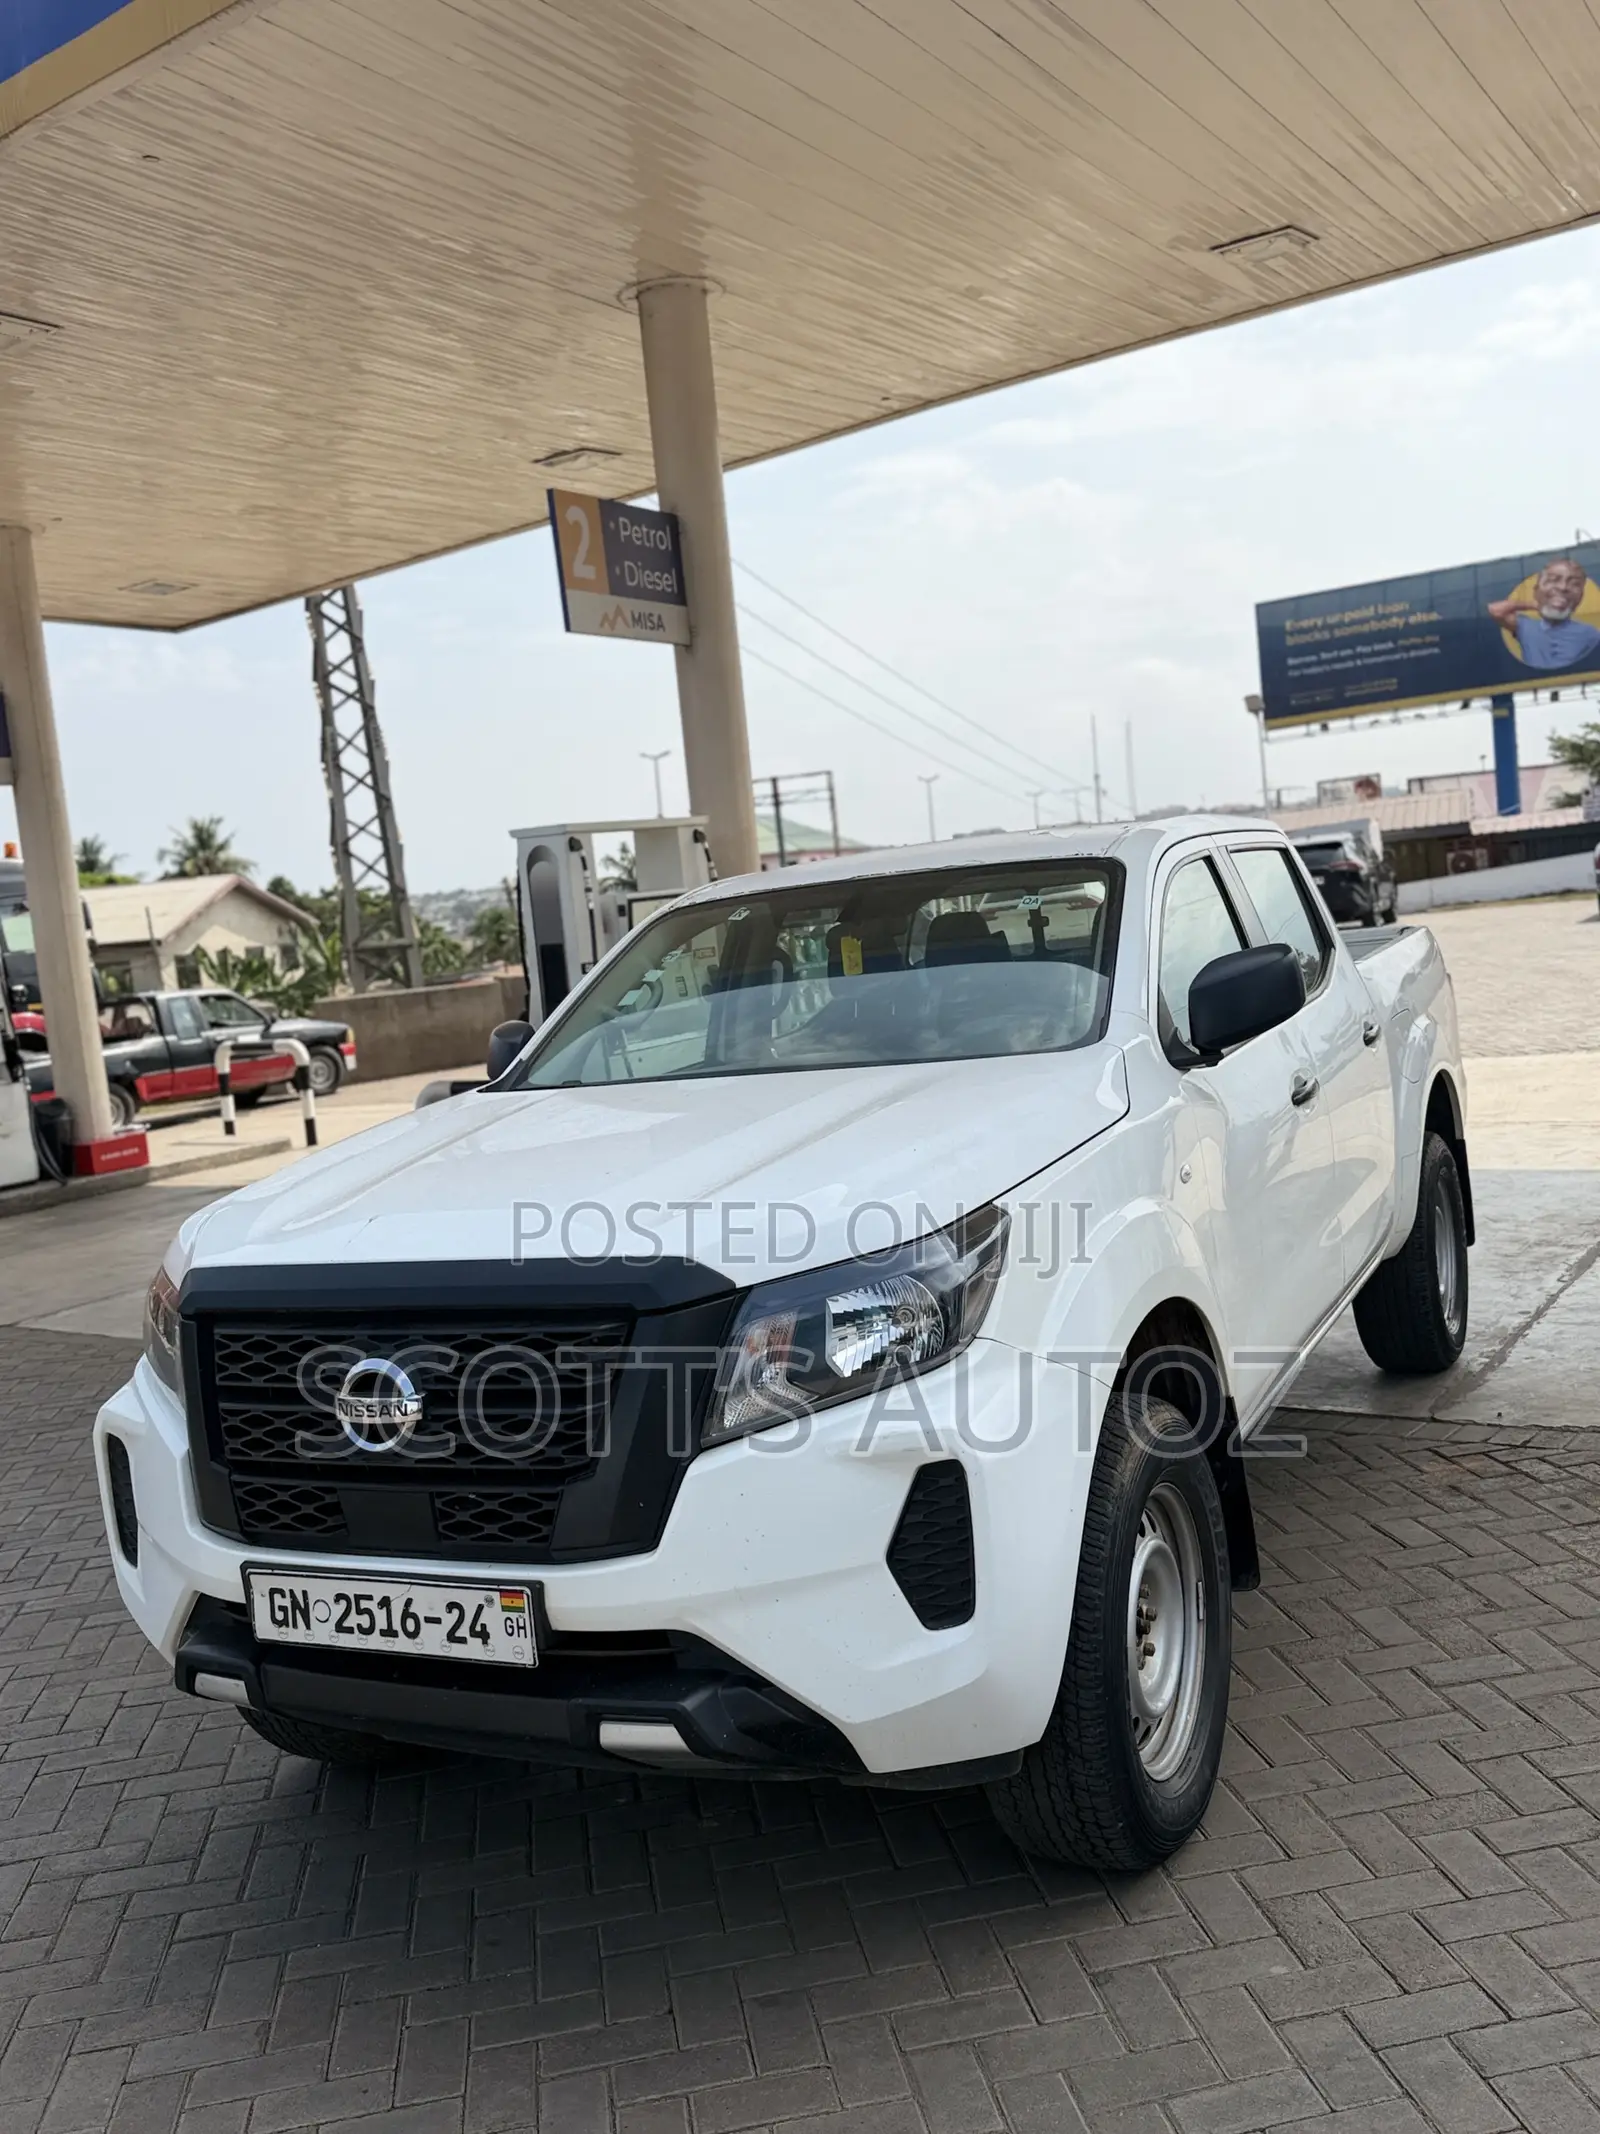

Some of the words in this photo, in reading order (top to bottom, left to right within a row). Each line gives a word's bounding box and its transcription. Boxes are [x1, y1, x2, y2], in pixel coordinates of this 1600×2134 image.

[565, 505, 596, 580] 2
[618, 516, 672, 551] Petrol
[624, 560, 678, 594] Diesel
[630, 609, 666, 632] MISA
[338, 1402, 408, 1418] NISSAN
[268, 1587, 311, 1630] GN
[333, 1592, 490, 1646] 2516-24
[504, 1615, 528, 1639] GH
